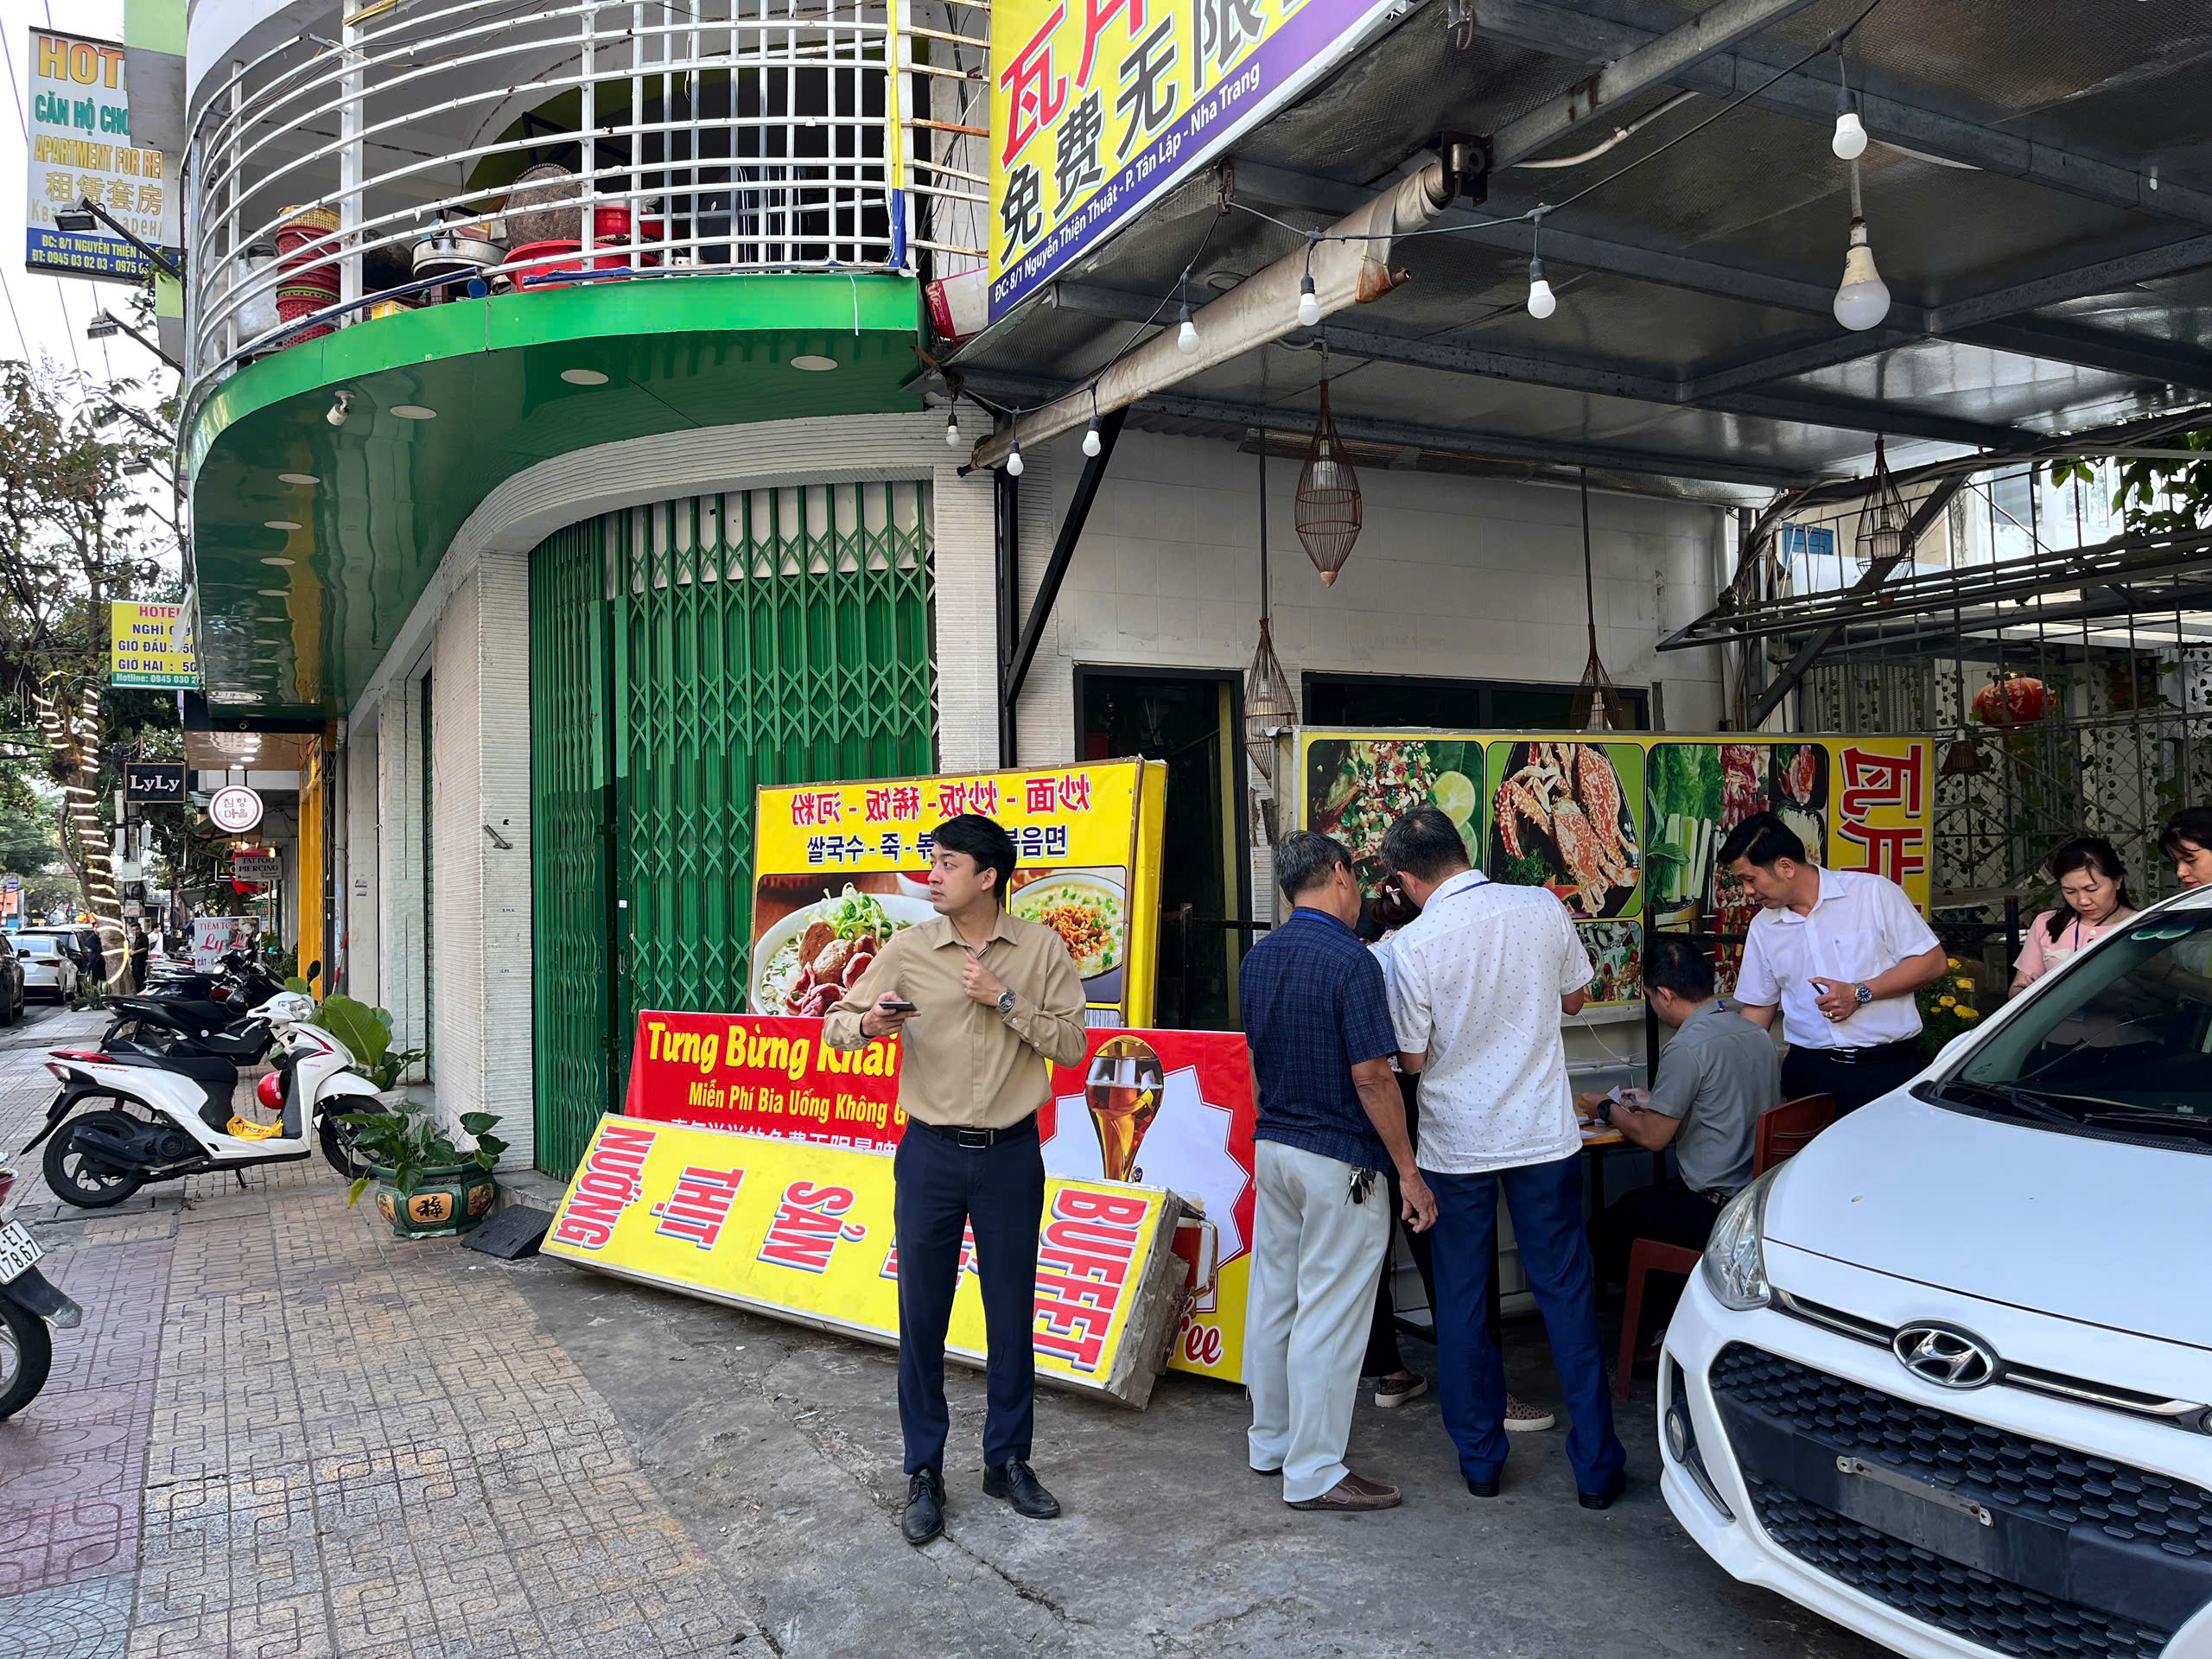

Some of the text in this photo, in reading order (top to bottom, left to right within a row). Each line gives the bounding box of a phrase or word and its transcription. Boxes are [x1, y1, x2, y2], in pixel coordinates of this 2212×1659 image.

[39, 36, 127, 91] HOT
[35, 91, 69, 126] CĂN
[73, 97, 96, 136] HỘ
[1000, 0, 1296, 265] 免费无限
[34, 134, 113, 172] APARTMENT
[115, 146, 140, 176] FOR
[995, 277, 1009, 303] ĐC:
[1010, 268, 1023, 289] 8/1
[1024, 235, 1058, 278] Nguyễn
[1059, 216, 1086, 248] Thiện
[1087, 185, 1117, 224] Thuật
[1125, 169, 1135, 192] P.
[1135, 156, 1156, 182] Tân
[1159, 134, 1181, 163] Lập
[1191, 101, 1217, 137] Nha
[1219, 62, 1260, 111] Trang
[48, 251, 69, 265] 0945
[70, 254, 82, 267] 03
[84, 256, 95, 269] 02
[96, 257, 108, 270] 03
[116, 260, 137, 274] 0975
[59, 237, 72, 251] 8/1
[75, 238, 110, 255] NGUYỄN
[116, 673, 149, 682] Hotline:
[150, 675, 171, 683] 0945
[143, 660, 163, 671] HAI
[130, 774, 181, 792] LyLy
[807, 835, 864, 863] 쌀국수
[880, 833, 900, 861] 죽
[1840, 745, 1923, 913] 瓦片
[200, 933, 225, 954] Ly
[648, 1022, 719, 1075] Tưng
[725, 1024, 810, 1080] Bừng
[689, 1079, 725, 1109] Miễn
[730, 1085, 754, 1111] Phí
[758, 1088, 783, 1114] Bia
[789, 1087, 830, 1124] Uống
[835, 1093, 889, 1129] Không
[553, 1125, 658, 1250] NƯỚNG
[651, 1166, 747, 1251] THỊT
[758, 1180, 867, 1274] SẢN
[1034, 1189, 1151, 1373] BUFFET
